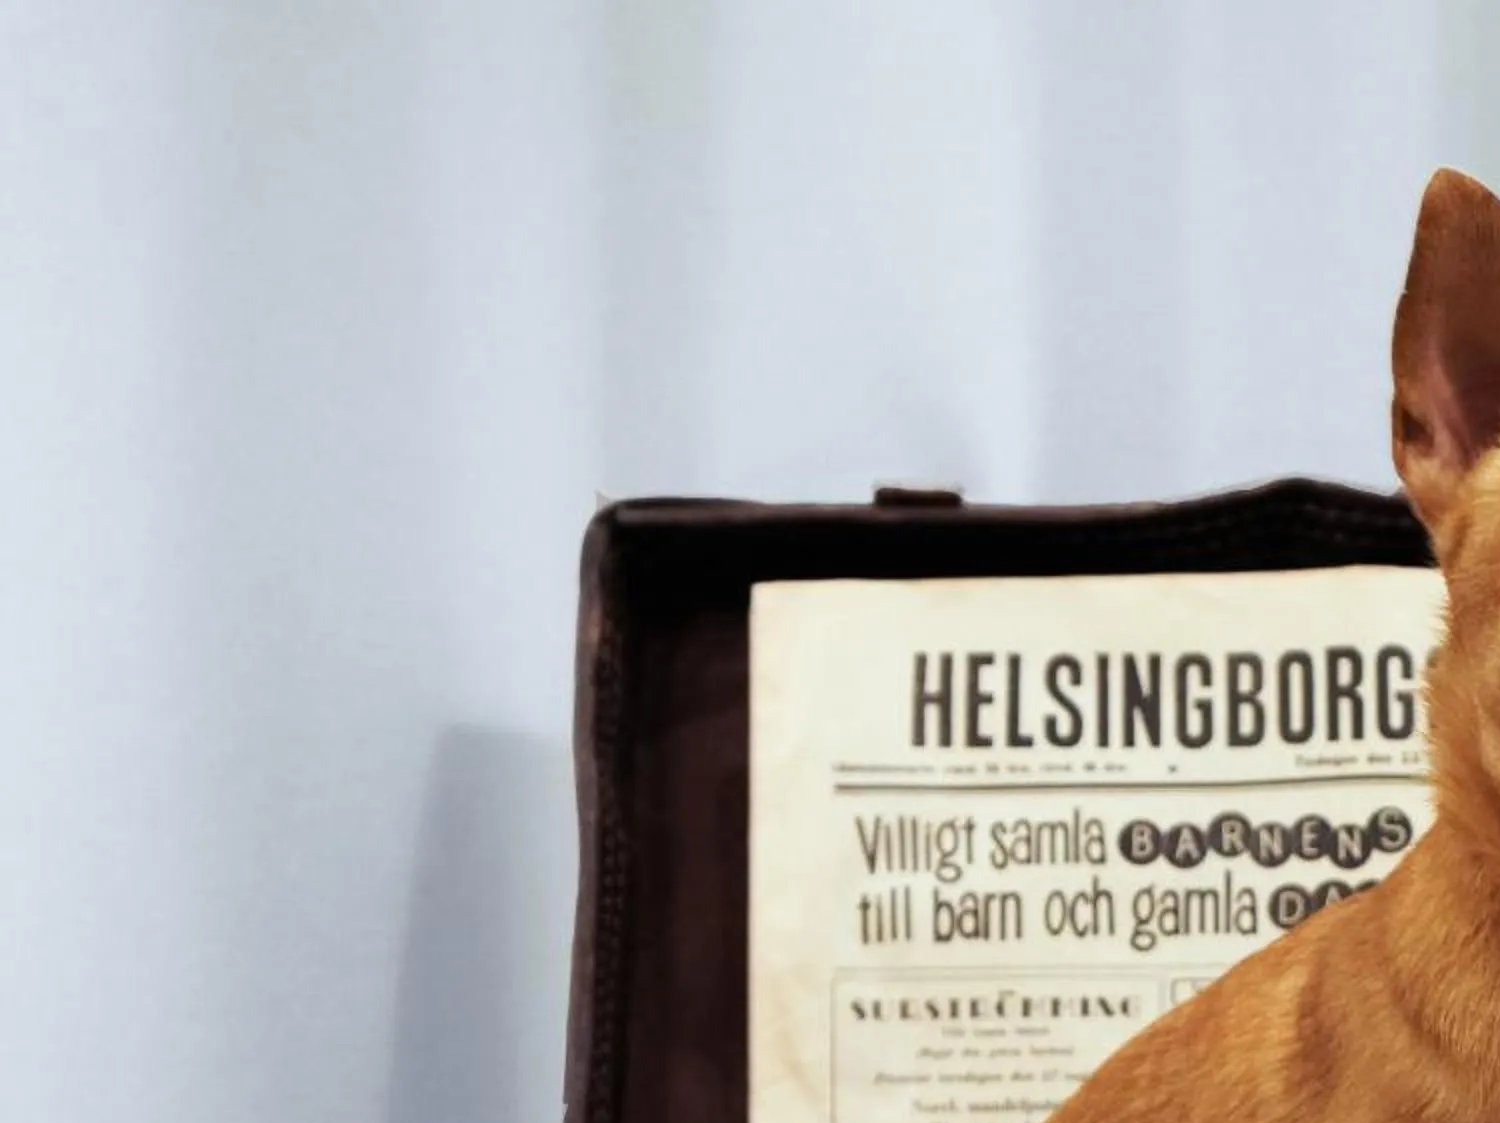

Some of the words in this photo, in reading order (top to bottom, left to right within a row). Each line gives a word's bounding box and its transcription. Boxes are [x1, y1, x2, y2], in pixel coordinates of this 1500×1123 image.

[911, 645, 1415, 748] HELSINGBORG
[855, 814, 975, 884] Villigt
[988, 806, 1108, 870] samla
[1118, 805, 1413, 870] BARNENS
[857, 884, 912, 945] till
[931, 886, 1023, 943] barn
[1044, 874, 1116, 938] och
[1130, 869, 1258, 951] gamla
